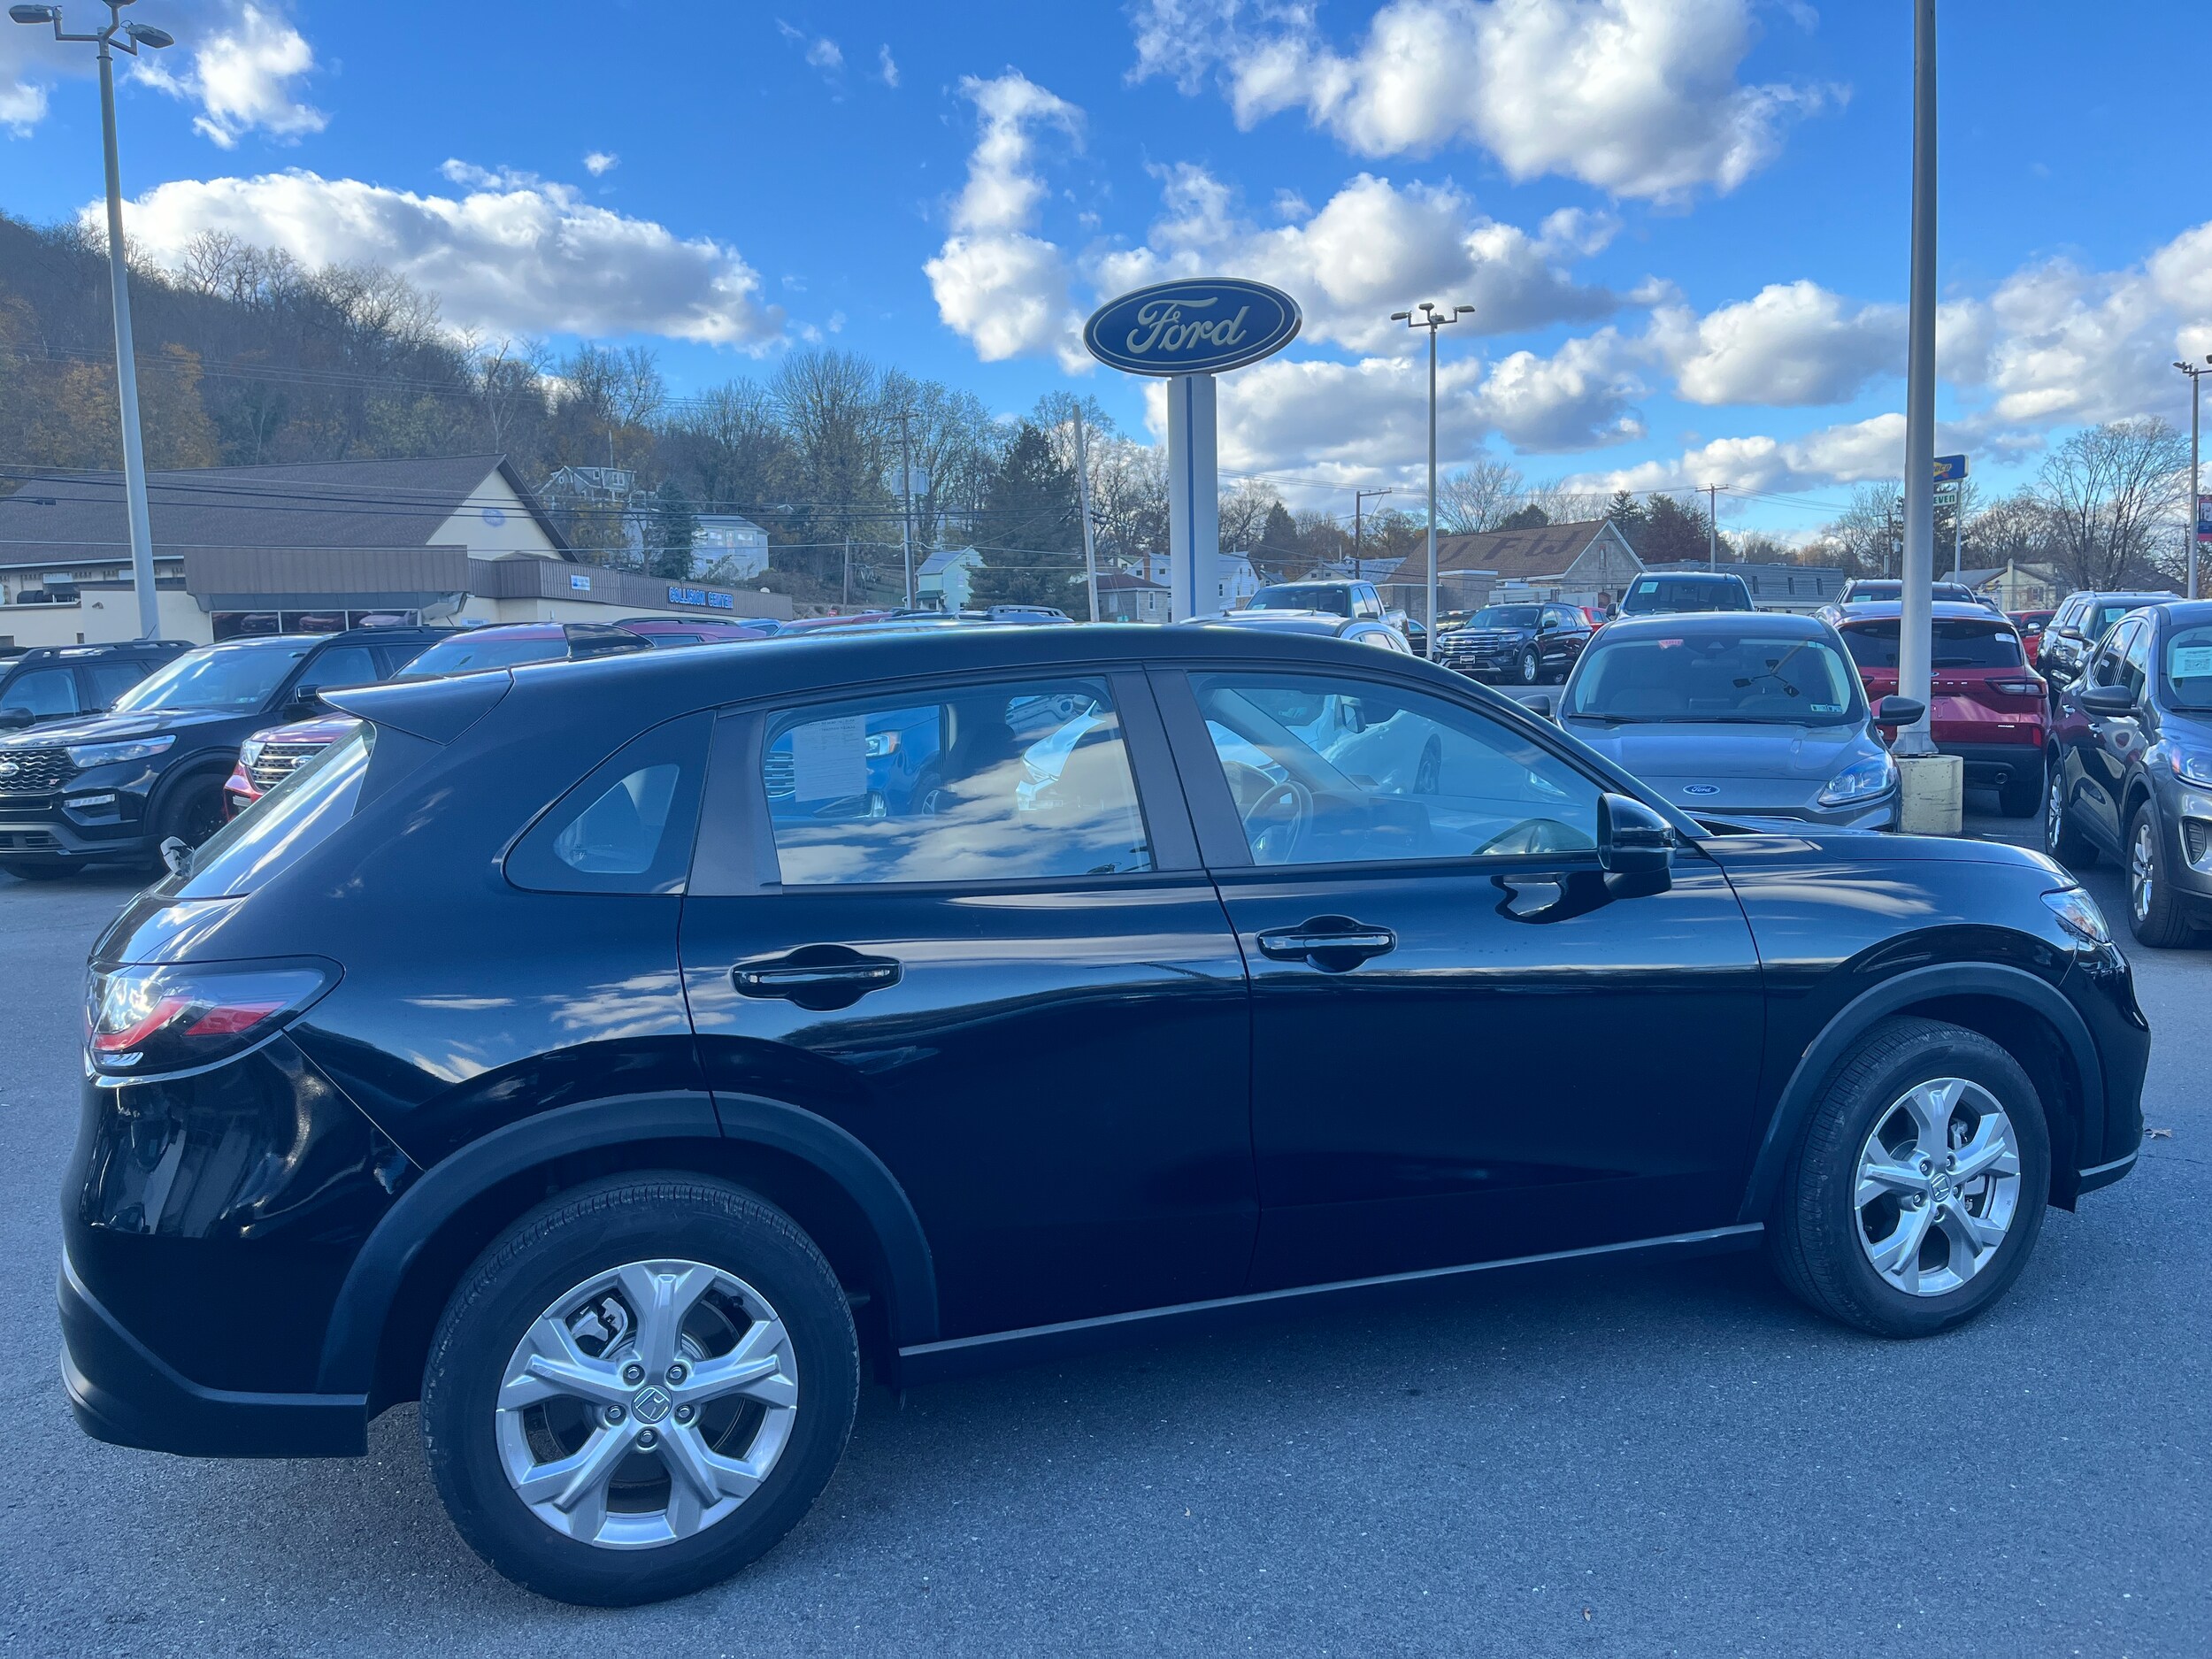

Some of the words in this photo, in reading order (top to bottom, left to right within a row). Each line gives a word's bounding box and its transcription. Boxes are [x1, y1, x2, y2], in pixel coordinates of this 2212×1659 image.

[1126, 296, 1250, 354] Ford
[668, 587, 706, 606] COLLISION
[707, 591, 734, 609] CENTER
